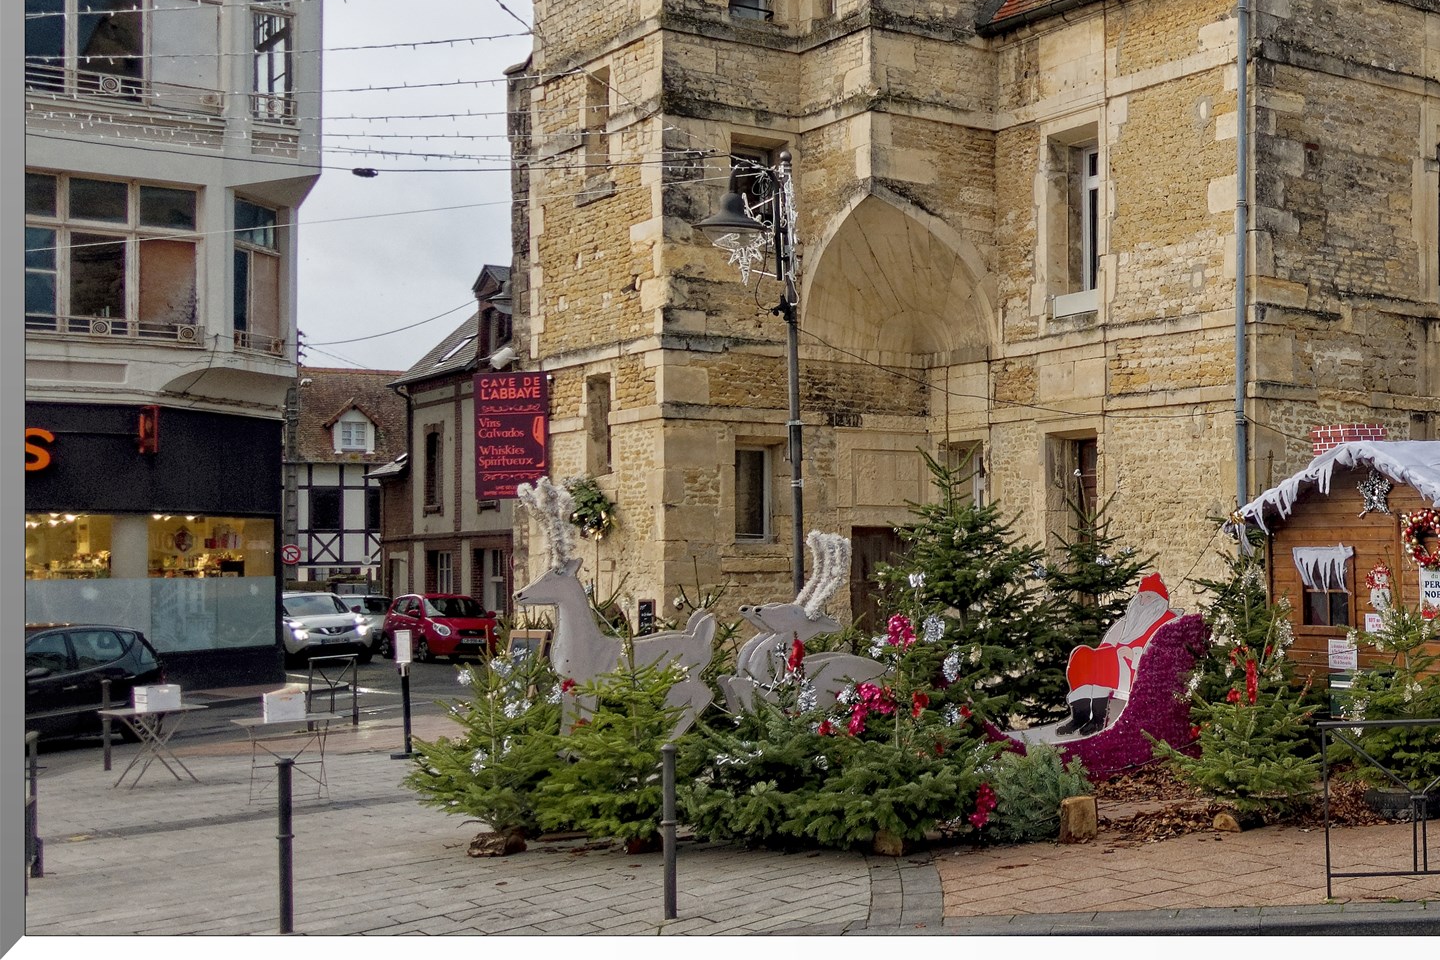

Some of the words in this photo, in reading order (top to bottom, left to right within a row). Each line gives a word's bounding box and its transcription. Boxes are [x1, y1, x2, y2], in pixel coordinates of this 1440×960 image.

[481, 378, 516, 387] CAVE
[524, 377, 540, 386] DE
[481, 388, 540, 400] L'ABBAYE
[479, 418, 501, 427] Vins
[478, 428, 525, 438] Calvados
[479, 445, 525, 455] Whiskies
[479, 457, 533, 468] Spiritueux
